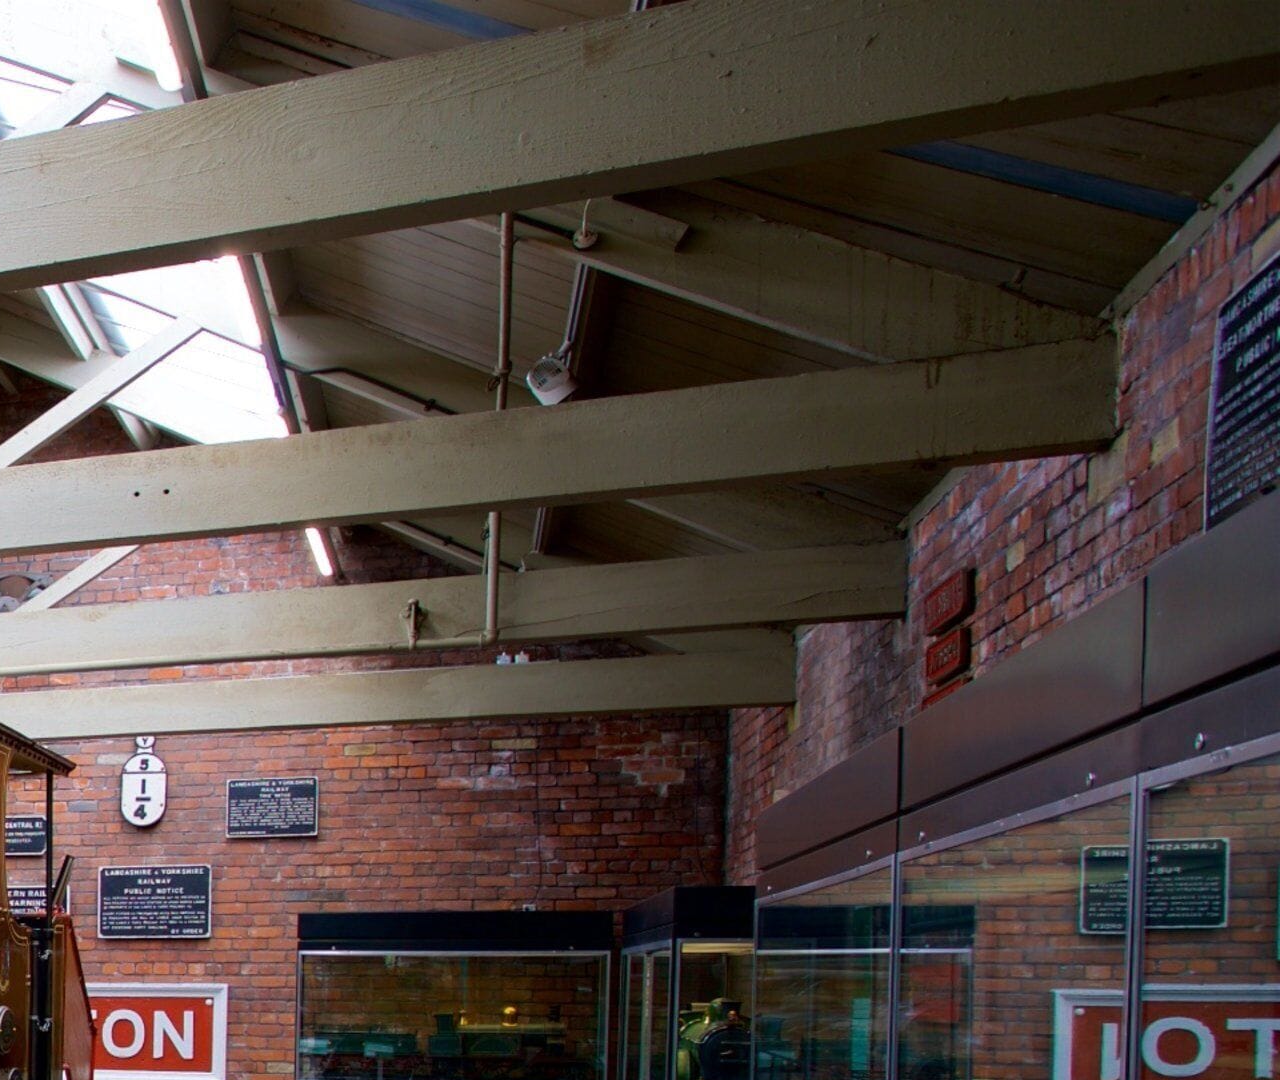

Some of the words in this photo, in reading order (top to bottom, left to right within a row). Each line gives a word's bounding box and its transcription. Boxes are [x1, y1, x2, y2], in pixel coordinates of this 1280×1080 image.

[139, 758, 149, 771] 5
[133, 804, 147, 820] 4
[91, 1008, 194, 1060] ON
